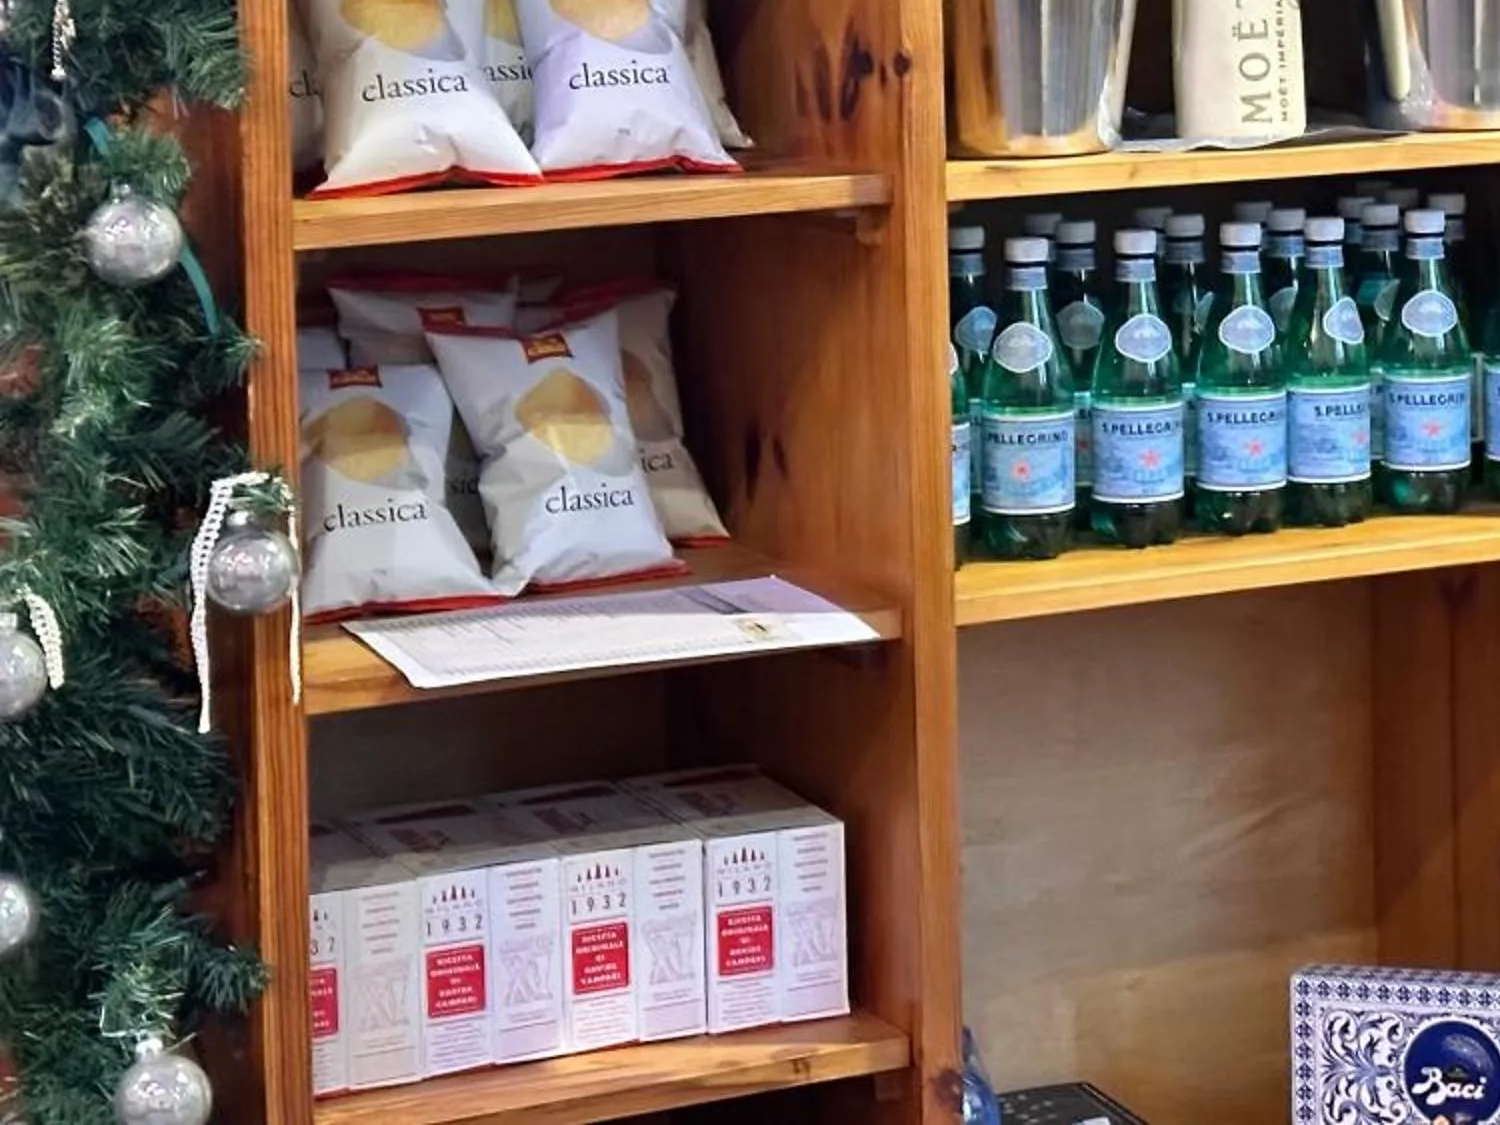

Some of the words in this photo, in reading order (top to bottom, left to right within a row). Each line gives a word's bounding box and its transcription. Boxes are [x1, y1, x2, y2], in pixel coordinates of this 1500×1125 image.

[361, 68, 468, 102] classica
[568, 59, 670, 91] classica
[323, 497, 428, 533] classica
[545, 482, 635, 514] classica
[1411, 1066, 1487, 1106] Baci
